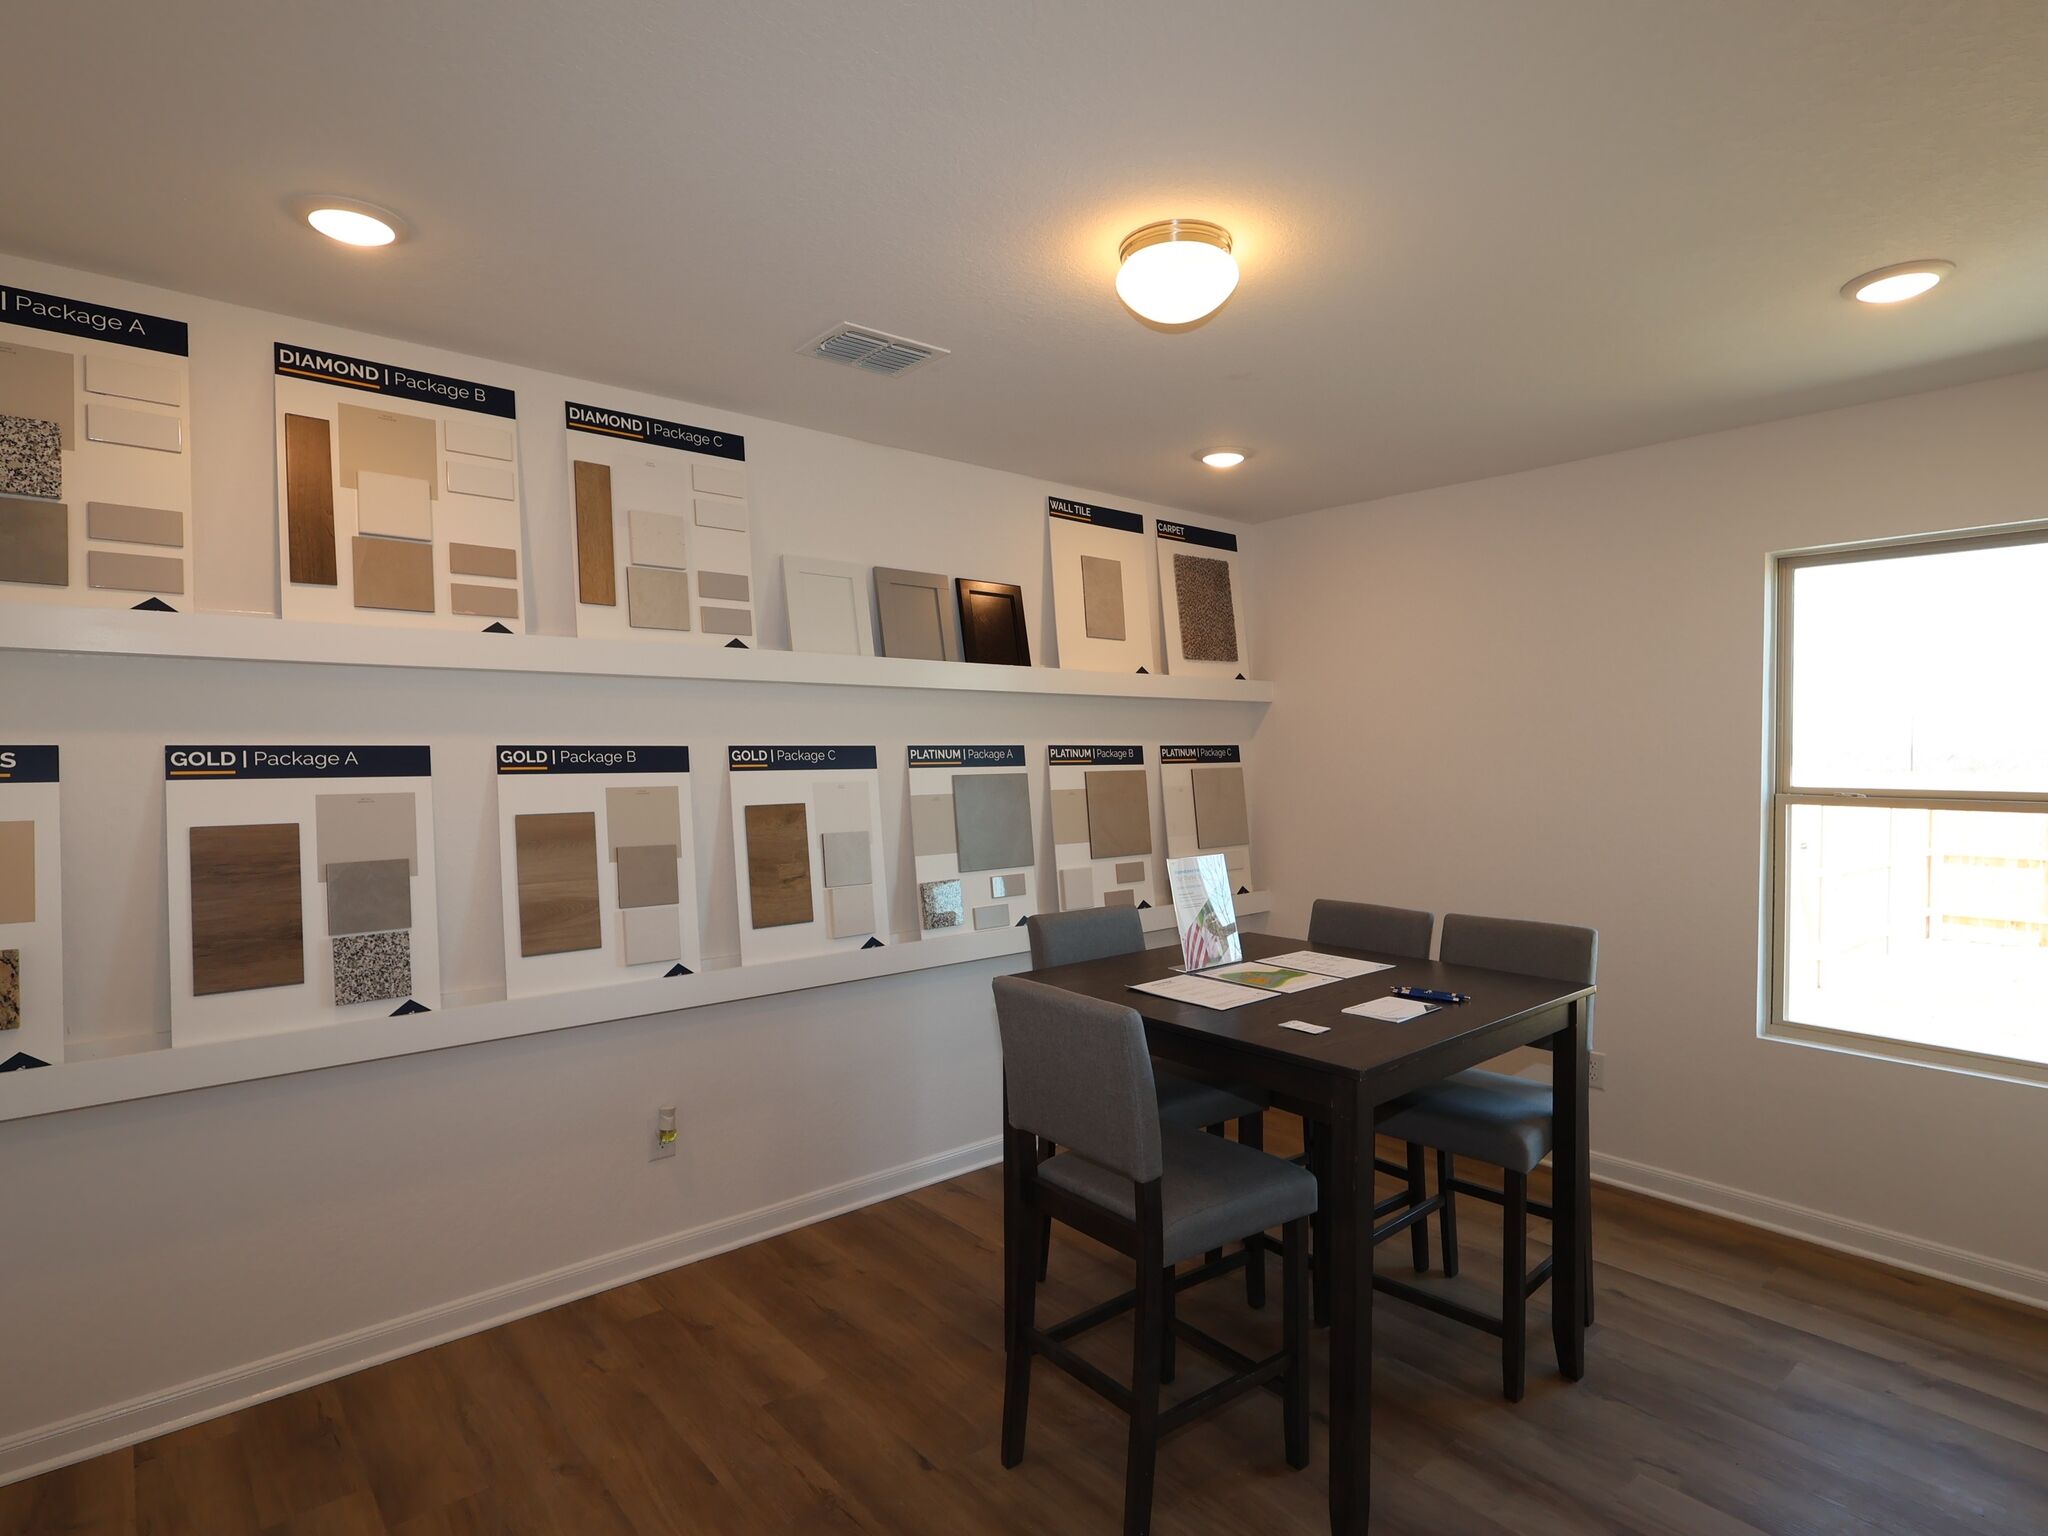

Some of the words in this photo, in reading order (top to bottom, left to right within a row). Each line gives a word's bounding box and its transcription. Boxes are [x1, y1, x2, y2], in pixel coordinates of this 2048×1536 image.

[15, 295, 122, 331] Package
[128, 318, 146, 336] A
[279, 349, 379, 380] DIAMOND
[394, 372, 470, 400] Package
[474, 388, 486, 402] B
[569, 406, 643, 432] DIAMOND
[653, 424, 710, 445] Package
[712, 435, 723, 448] C
[1050, 500, 1073, 513] WALL
[1074, 505, 1091, 516] TILE
[1157, 523, 1185, 536] CARPET
[170, 751, 236, 767] GOLD
[254, 751, 340, 769] Package
[344, 751, 359, 766] A
[500, 751, 548, 764] GOLD
[560, 750, 622, 766] Package
[626, 750, 637, 763] B
[731, 750, 768, 762] GOLD
[776, 750, 825, 763] Package
[827, 750, 836, 761] C
[910, 749, 961, 760] PLATINUM
[968, 750, 1005, 761] Package
[1006, 750, 1013, 759] A
[1050, 748, 1092, 758] PLATINUM
[1096, 749, 1127, 761] Package
[1128, 749, 1134, 758] B
[1161, 748, 1197, 758] PLATINUM
[1200, 748, 1226, 760] Package
[1226, 748, 1233, 757] C
